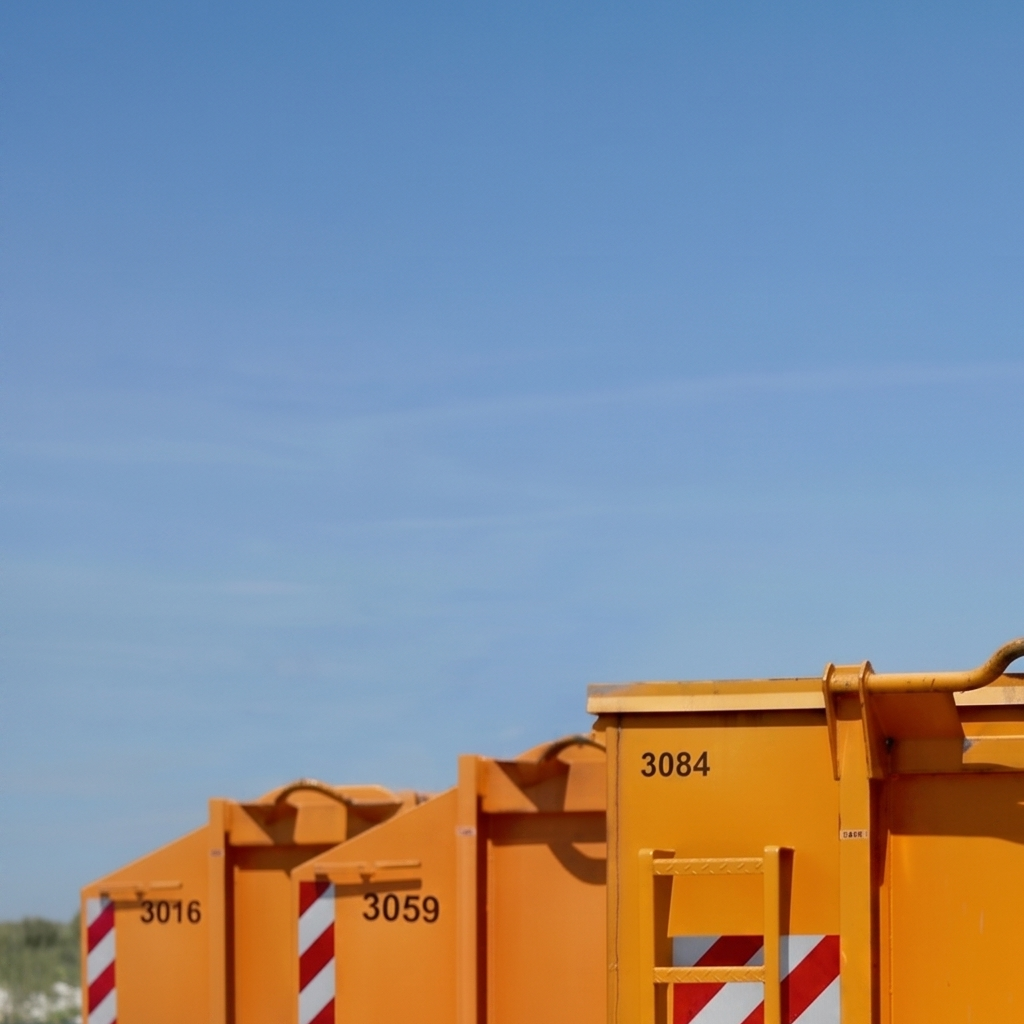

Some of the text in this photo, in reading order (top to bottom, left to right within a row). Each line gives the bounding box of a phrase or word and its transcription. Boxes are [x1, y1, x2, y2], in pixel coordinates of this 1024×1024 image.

[641, 751, 710, 777] 3084
[140, 900, 201, 924] 3016
[363, 892, 440, 923] 3059
